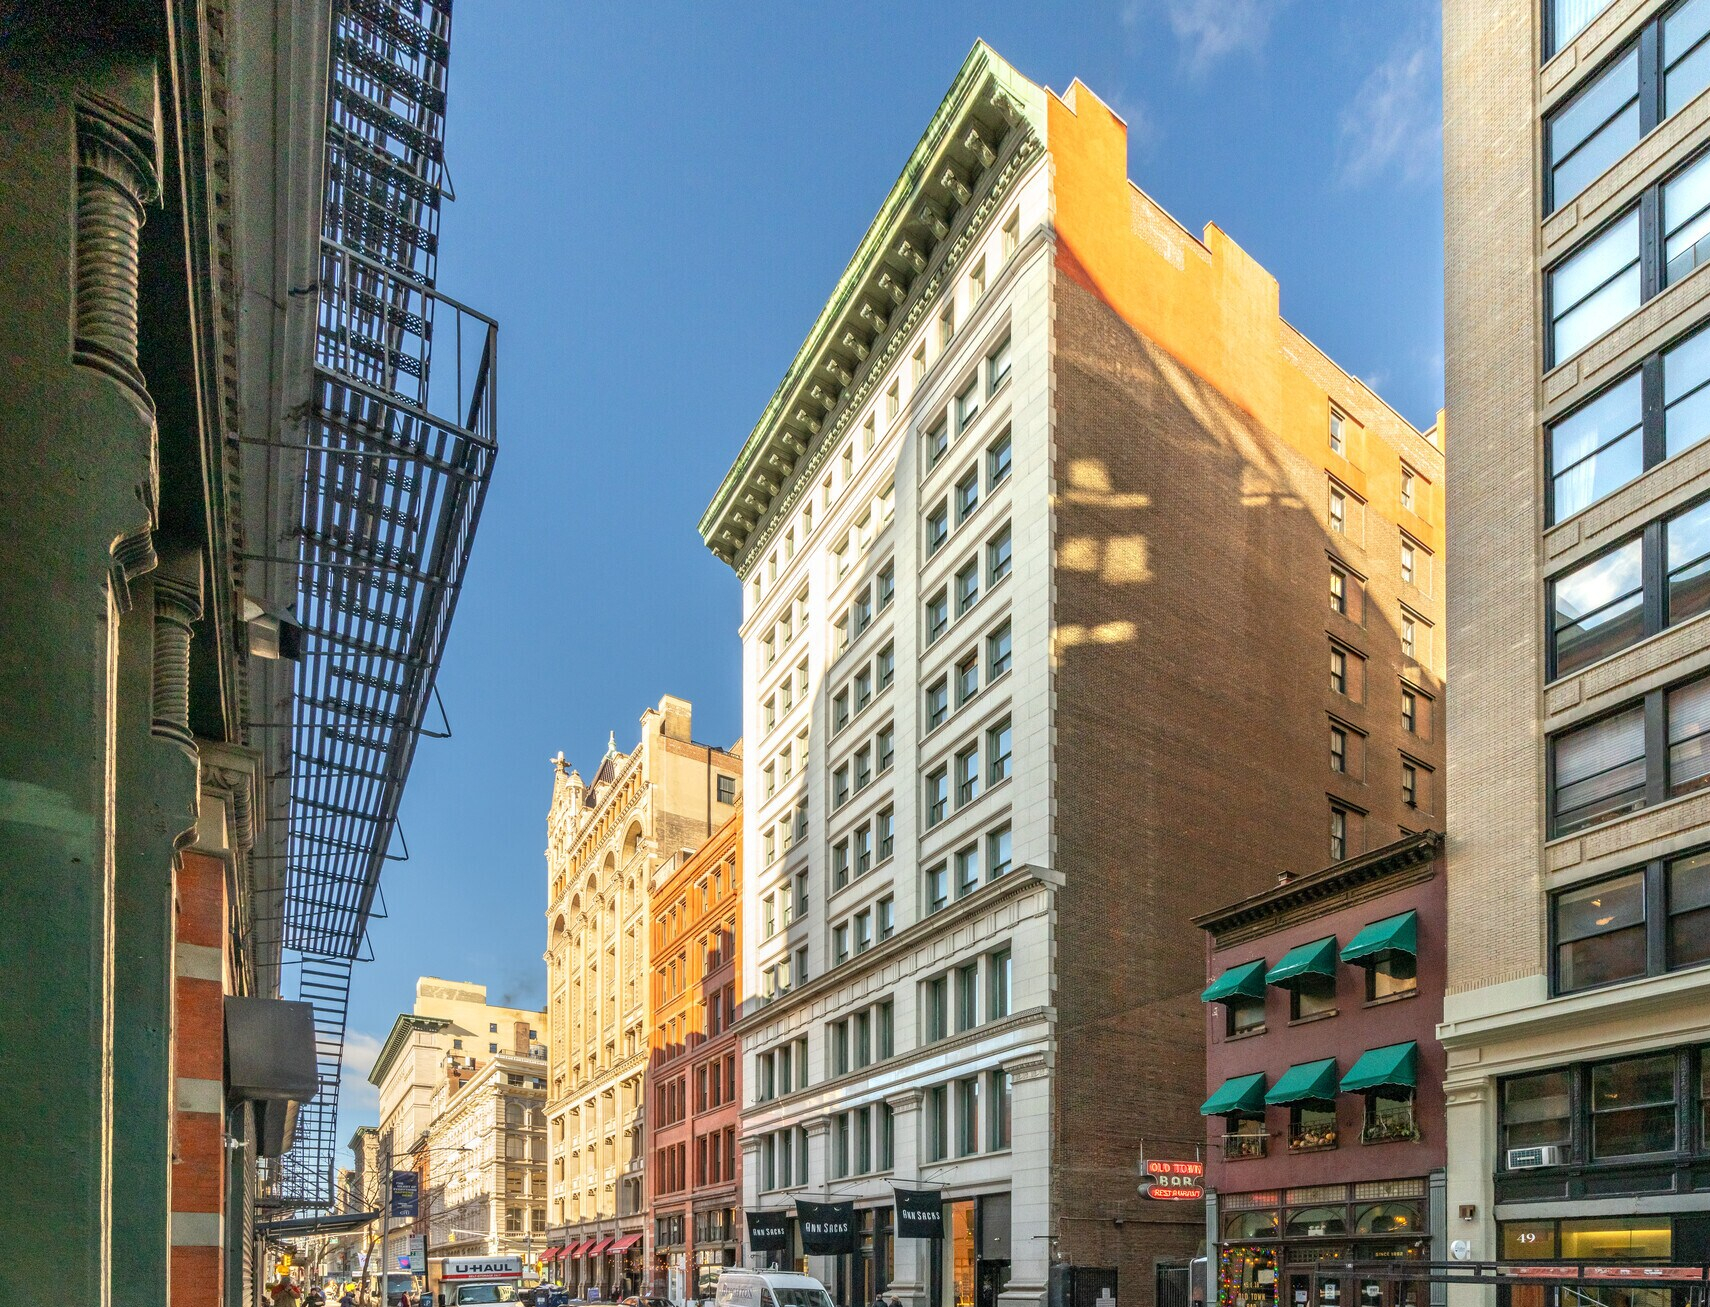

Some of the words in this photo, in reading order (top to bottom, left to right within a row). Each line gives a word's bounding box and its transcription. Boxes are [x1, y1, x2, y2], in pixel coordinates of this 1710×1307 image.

[1149, 1162, 1171, 1173] OLD
[1172, 1163, 1202, 1175] TOWN
[1159, 1175, 1192, 1187] BAR
[1152, 1189, 1201, 1197] RESTAURANT
[902, 1209, 916, 1220] ANN
[917, 1210, 941, 1221] SACKS
[752, 1228, 765, 1236] ANN
[765, 1227, 785, 1236] SACKS
[805, 1222, 822, 1233] ANN
[823, 1222, 848, 1233] SACKS
[1516, 1232, 1536, 1244] 49
[455, 1263, 513, 1273] U-HAUL
[1251, 1292, 1266, 1301] TOWN
